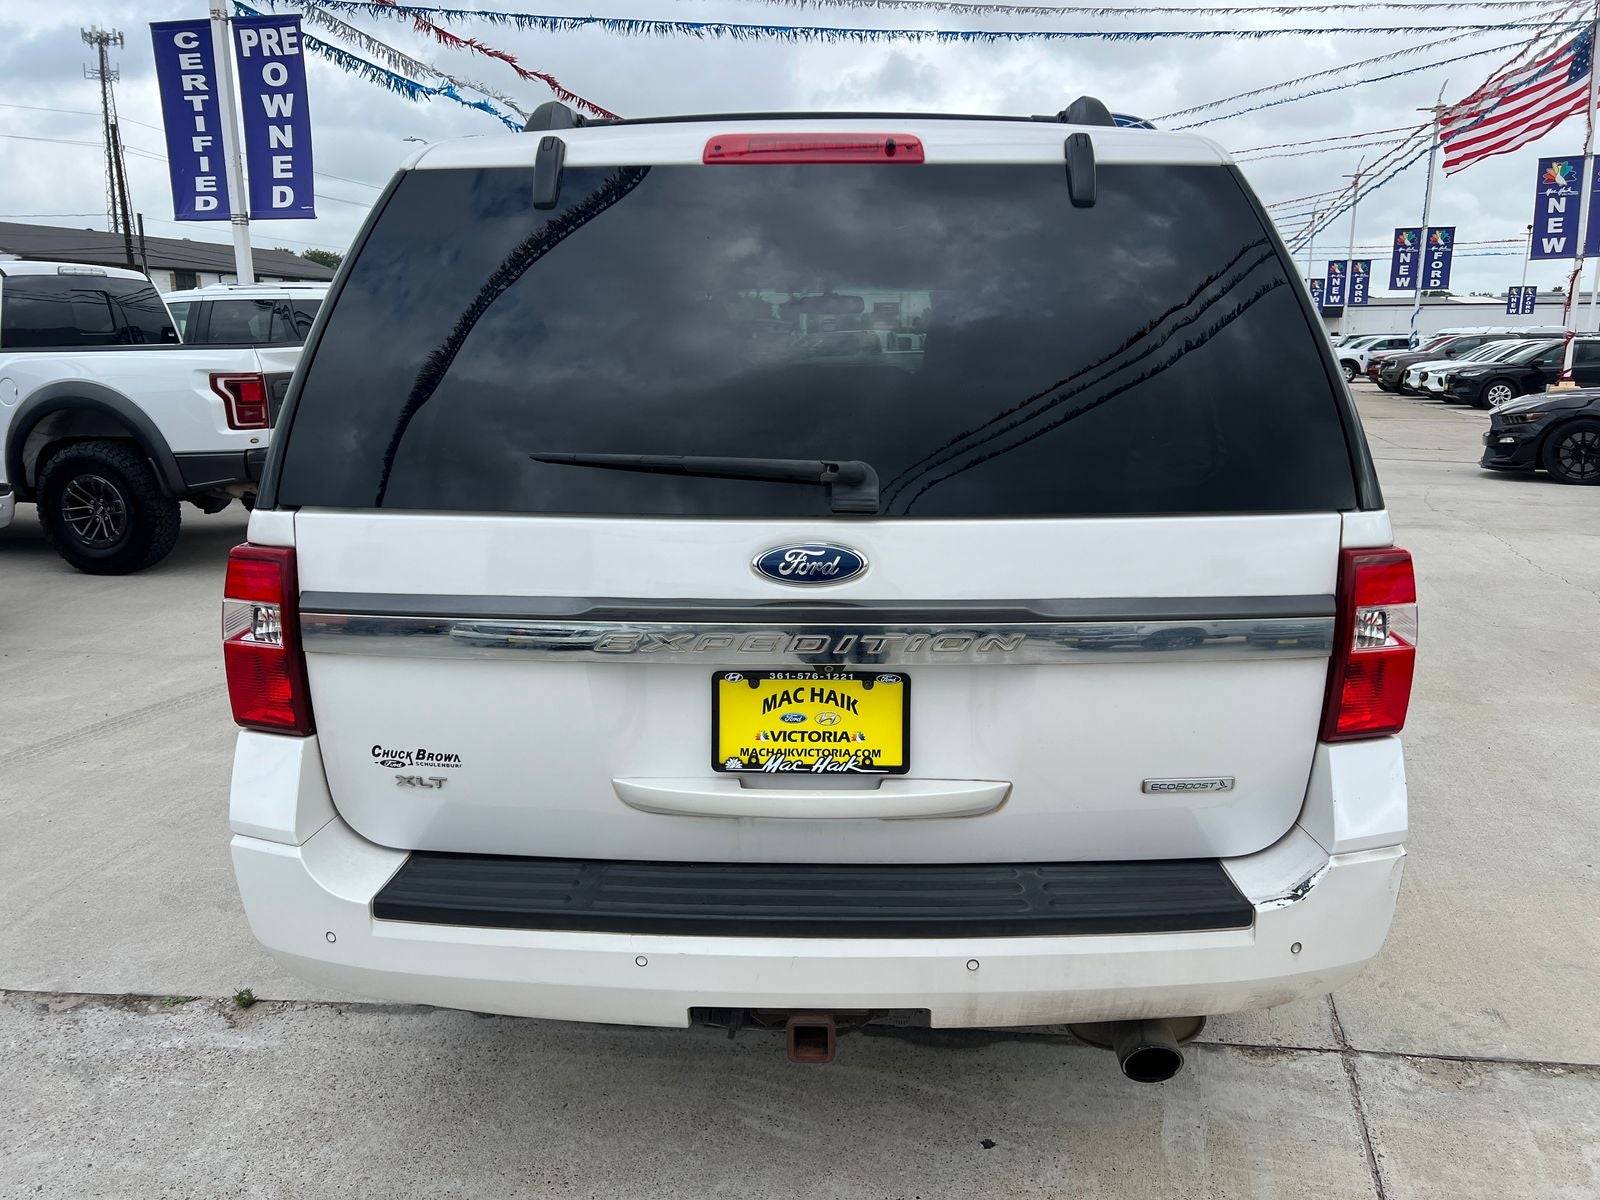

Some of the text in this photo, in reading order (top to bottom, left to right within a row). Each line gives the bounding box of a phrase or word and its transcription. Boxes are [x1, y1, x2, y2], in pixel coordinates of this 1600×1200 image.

[239, 26, 300, 57] PRE
[173, 31, 218, 212] CERTIFIED
[260, 62, 295, 209] OWNED
[1542, 197, 1567, 254] NEW
[1395, 252, 1411, 288] NEW
[1429, 251, 1443, 287] FORD
[1329, 278, 1341, 303] NEW
[1354, 277, 1363, 303] FORD
[1509, 297, 1517, 314] NEW
[778, 548, 840, 576] Ford
[593, 631, 1027, 655] EXPEDITION
[769, 672, 854, 681] 361-576-1221
[762, 687, 859, 716] MAC HAIK
[783, 713, 803, 723] Ford
[769, 730, 851, 743] VICTORIA
[740, 747, 881, 758] MACHAIKVICTORIA.COM
[761, 754, 864, 773] Mac Haik
[395, 774, 448, 789] XLT
